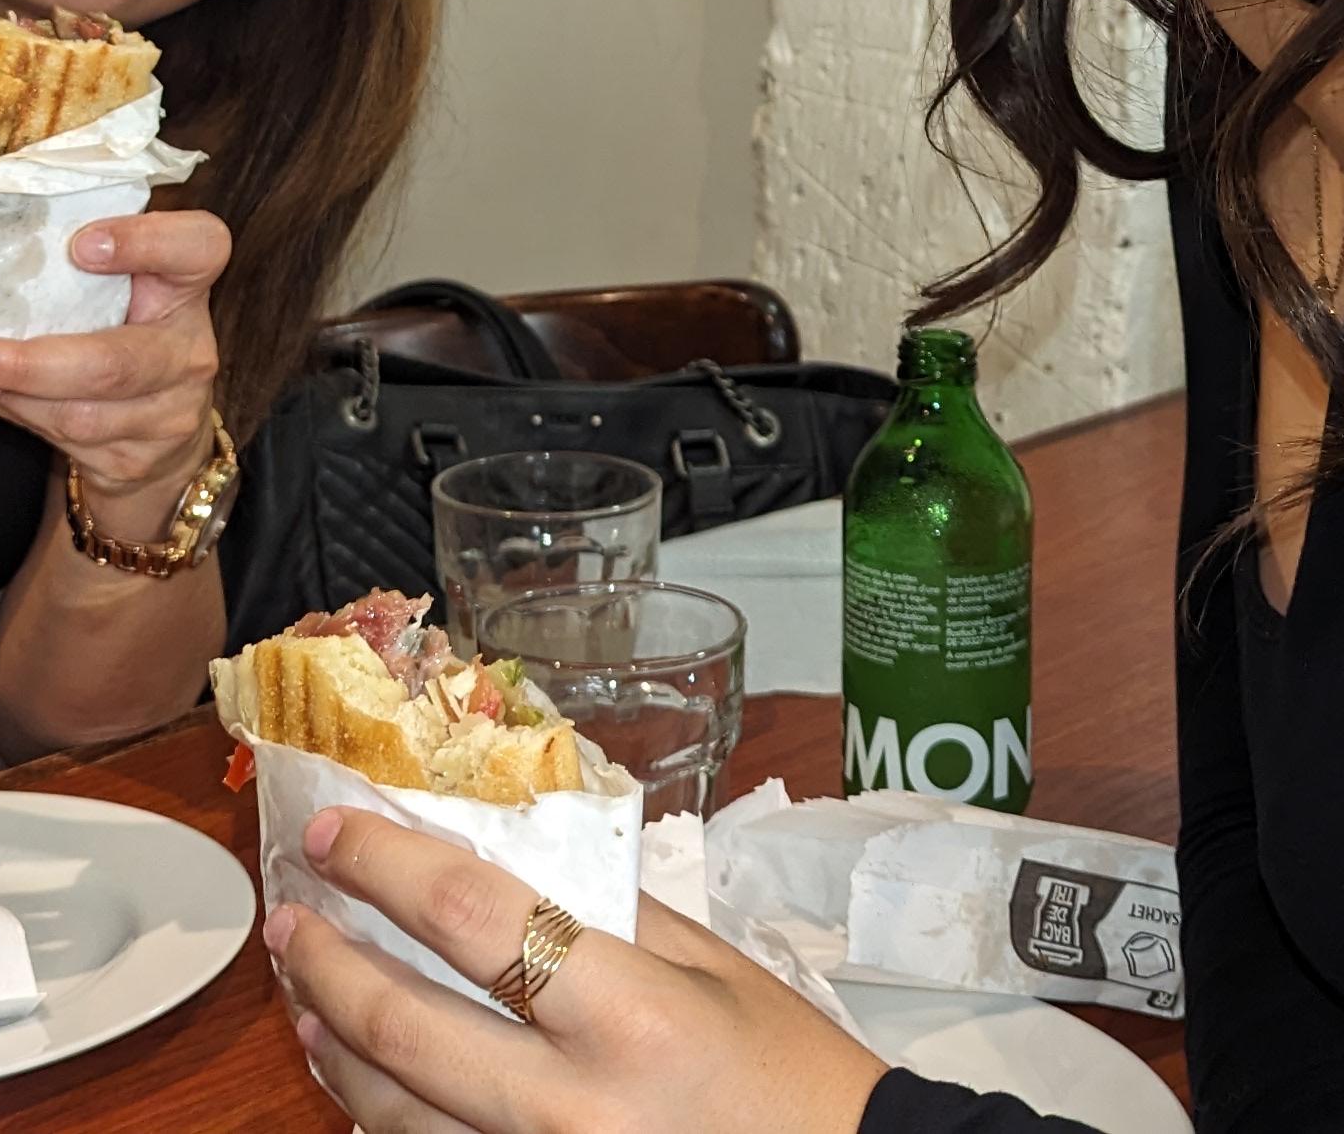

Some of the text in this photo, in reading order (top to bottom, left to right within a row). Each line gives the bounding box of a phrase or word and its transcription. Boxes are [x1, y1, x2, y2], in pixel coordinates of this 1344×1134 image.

[843, 702, 1032, 804] MON
[1049, 881, 1076, 907] TRI
[1045, 904, 1069, 925] DE
[1127, 901, 1182, 927] SACHET
[1041, 920, 1073, 947] BAC
